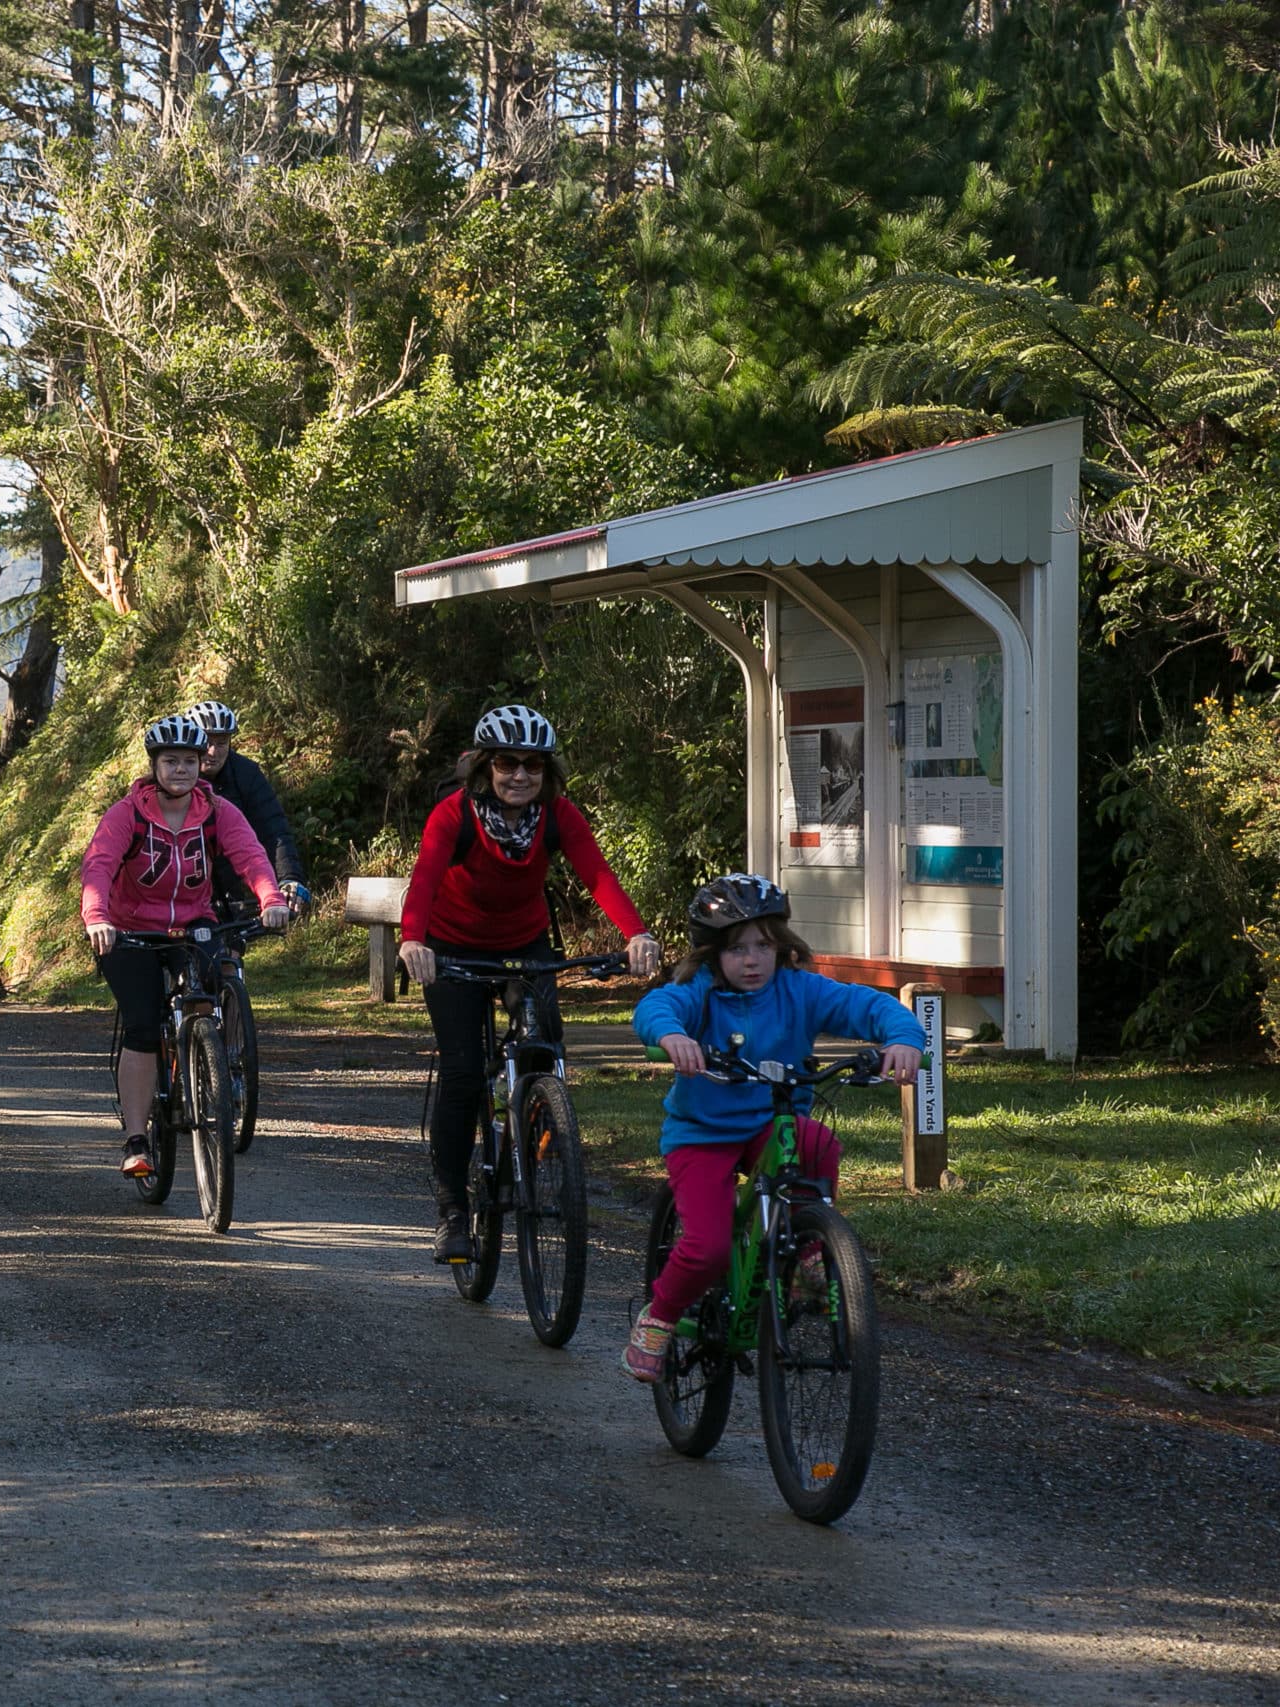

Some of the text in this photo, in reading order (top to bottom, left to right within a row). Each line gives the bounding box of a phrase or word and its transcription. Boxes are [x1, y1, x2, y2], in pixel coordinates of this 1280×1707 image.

[137, 834, 208, 889] 73
[924, 1001, 934, 1031] 10km
[924, 1034, 933, 1047] to
[926, 1098, 935, 1131] Yards
